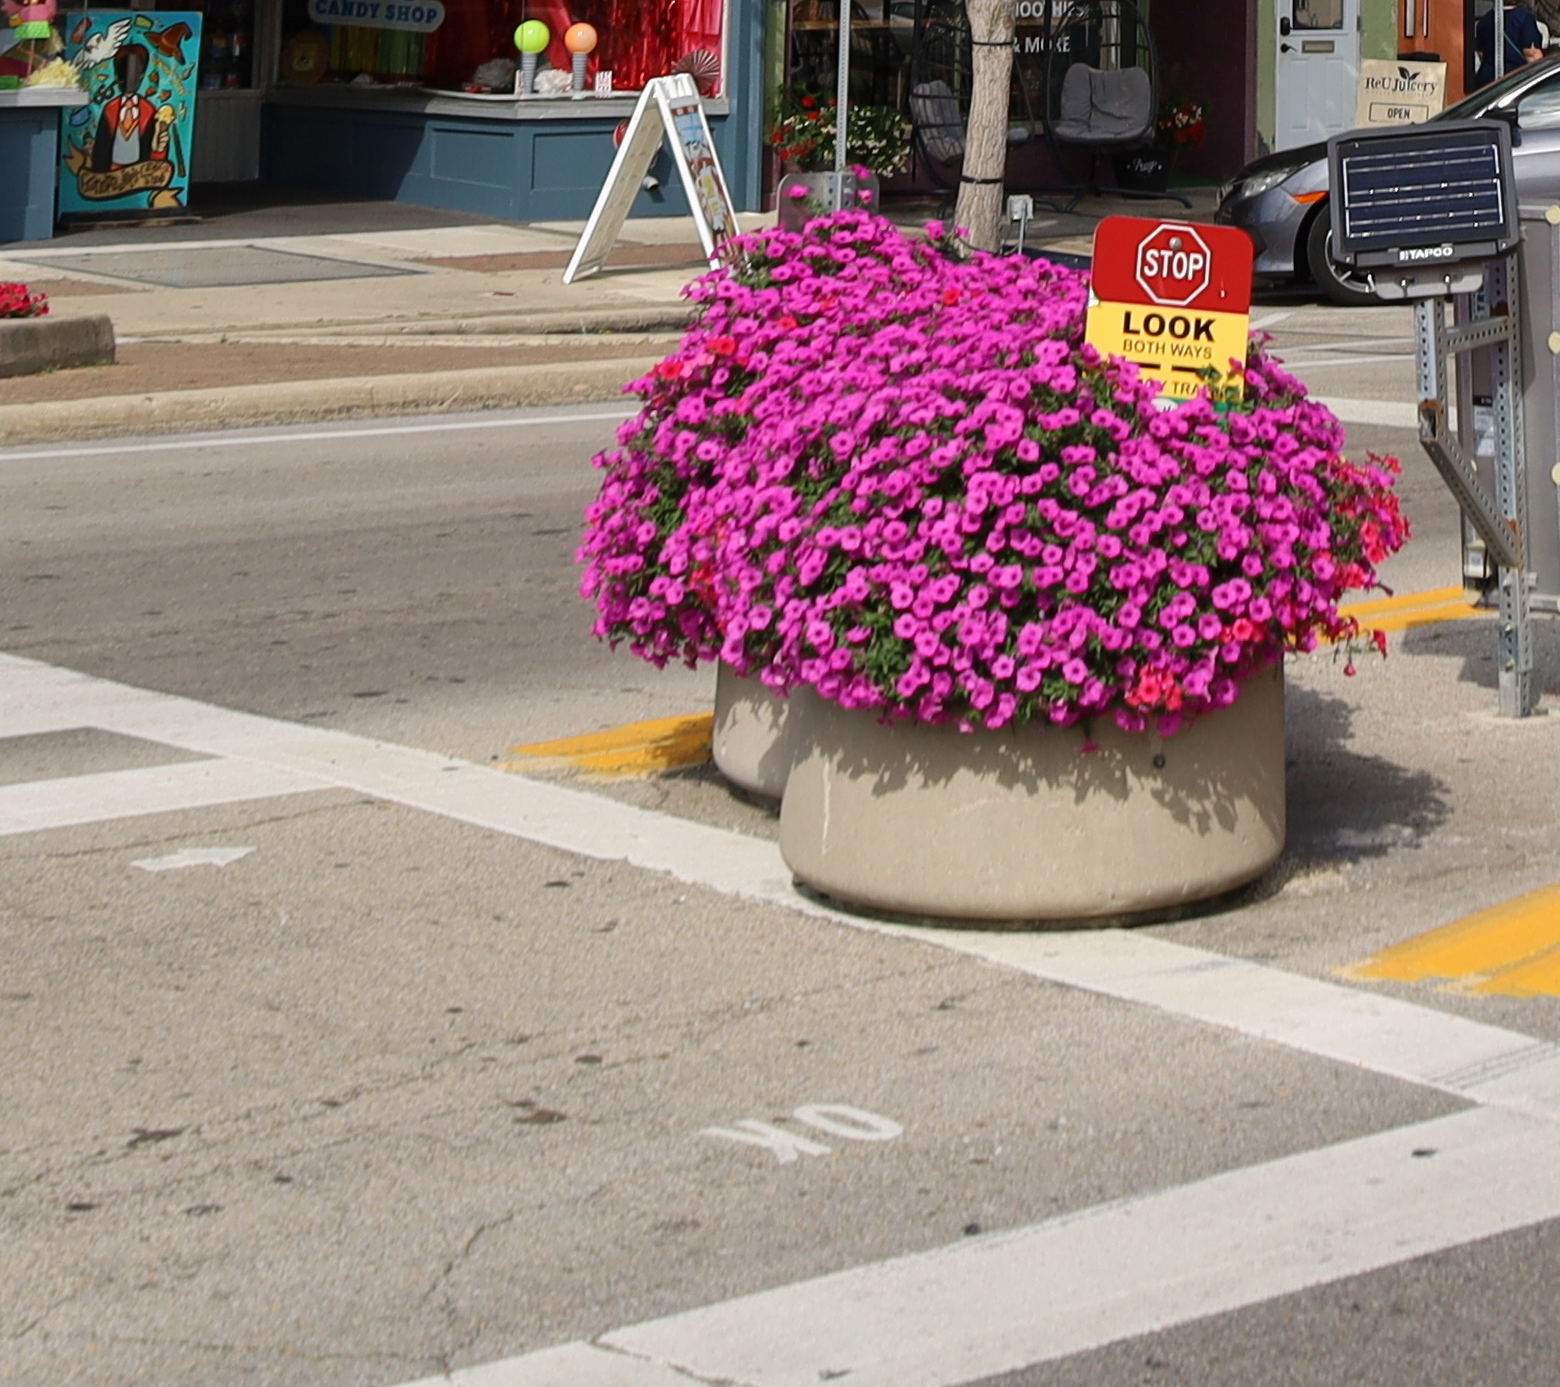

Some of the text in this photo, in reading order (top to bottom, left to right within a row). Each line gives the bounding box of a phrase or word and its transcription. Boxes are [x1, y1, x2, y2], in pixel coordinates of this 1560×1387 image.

[385, 3, 438, 24] SHOP
[1366, 75, 1438, 96] ReU Juicery
[1387, 108, 1411, 120] OPEN
[1410, 246, 1453, 260] TAPCO
[1143, 248, 1204, 281] STOP
[1122, 310, 1217, 343] LOOK
[1122, 338, 1213, 360] BOTH WAYS
